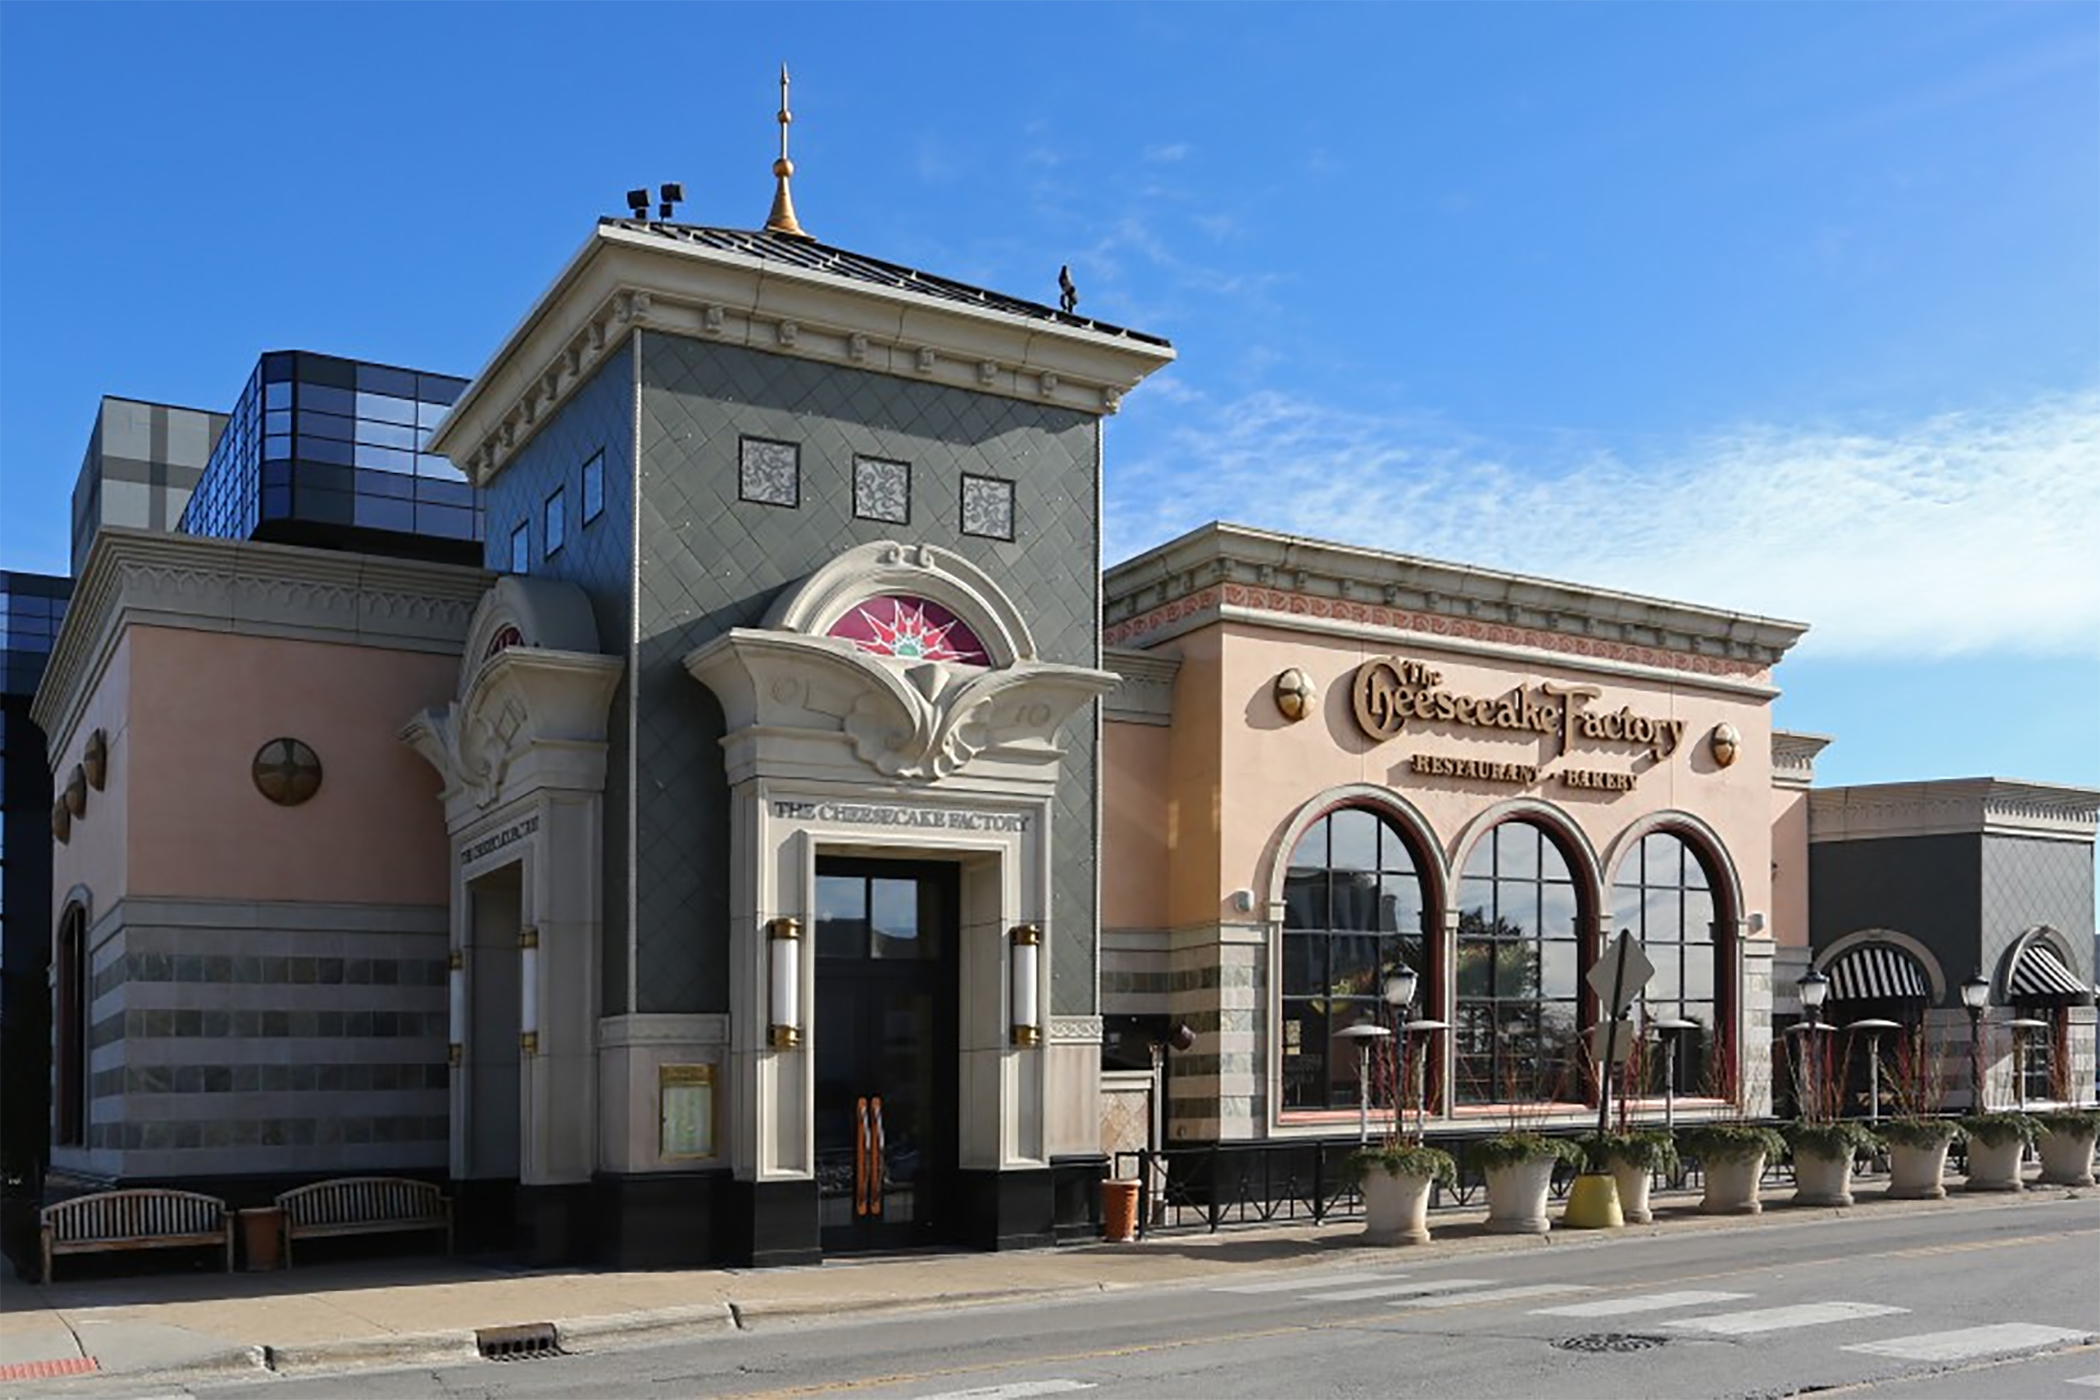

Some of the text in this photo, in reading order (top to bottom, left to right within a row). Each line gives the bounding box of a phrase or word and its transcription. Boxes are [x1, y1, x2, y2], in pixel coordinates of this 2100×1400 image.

[1402, 660, 1442, 687] The
[1354, 656, 1688, 763] Cheesecake Factory
[1412, 754, 1638, 791] RESTAURANT BAKERY
[774, 801, 1030, 832] THE CHEESECAKE FACTORY
